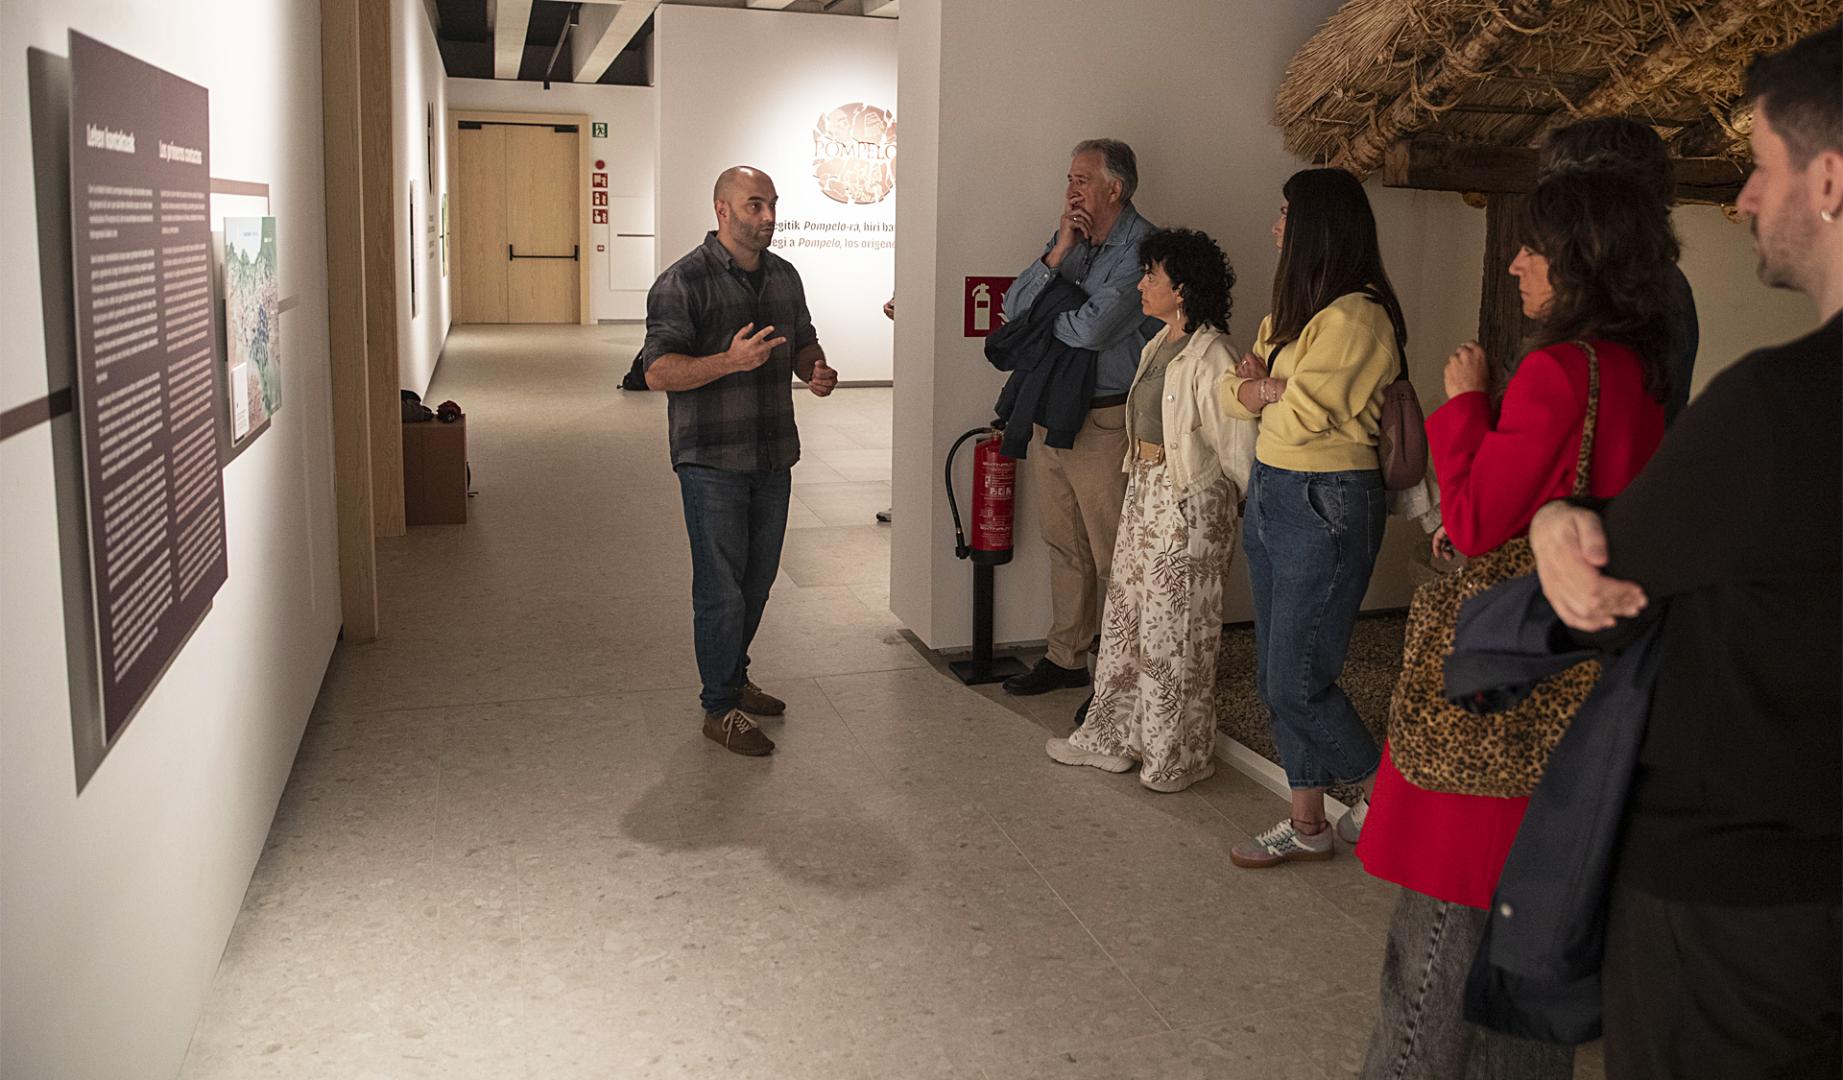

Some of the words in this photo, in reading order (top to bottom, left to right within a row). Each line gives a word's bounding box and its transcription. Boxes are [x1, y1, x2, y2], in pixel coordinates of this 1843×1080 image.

[813, 140, 897, 160] POMPELO
[804, 220, 861, 232] Pompelo-ra,
[864, 221, 880, 232] hiri
[882, 221, 895, 232] ba
[789, 239, 795, 247] a
[844, 238, 859, 248] los
